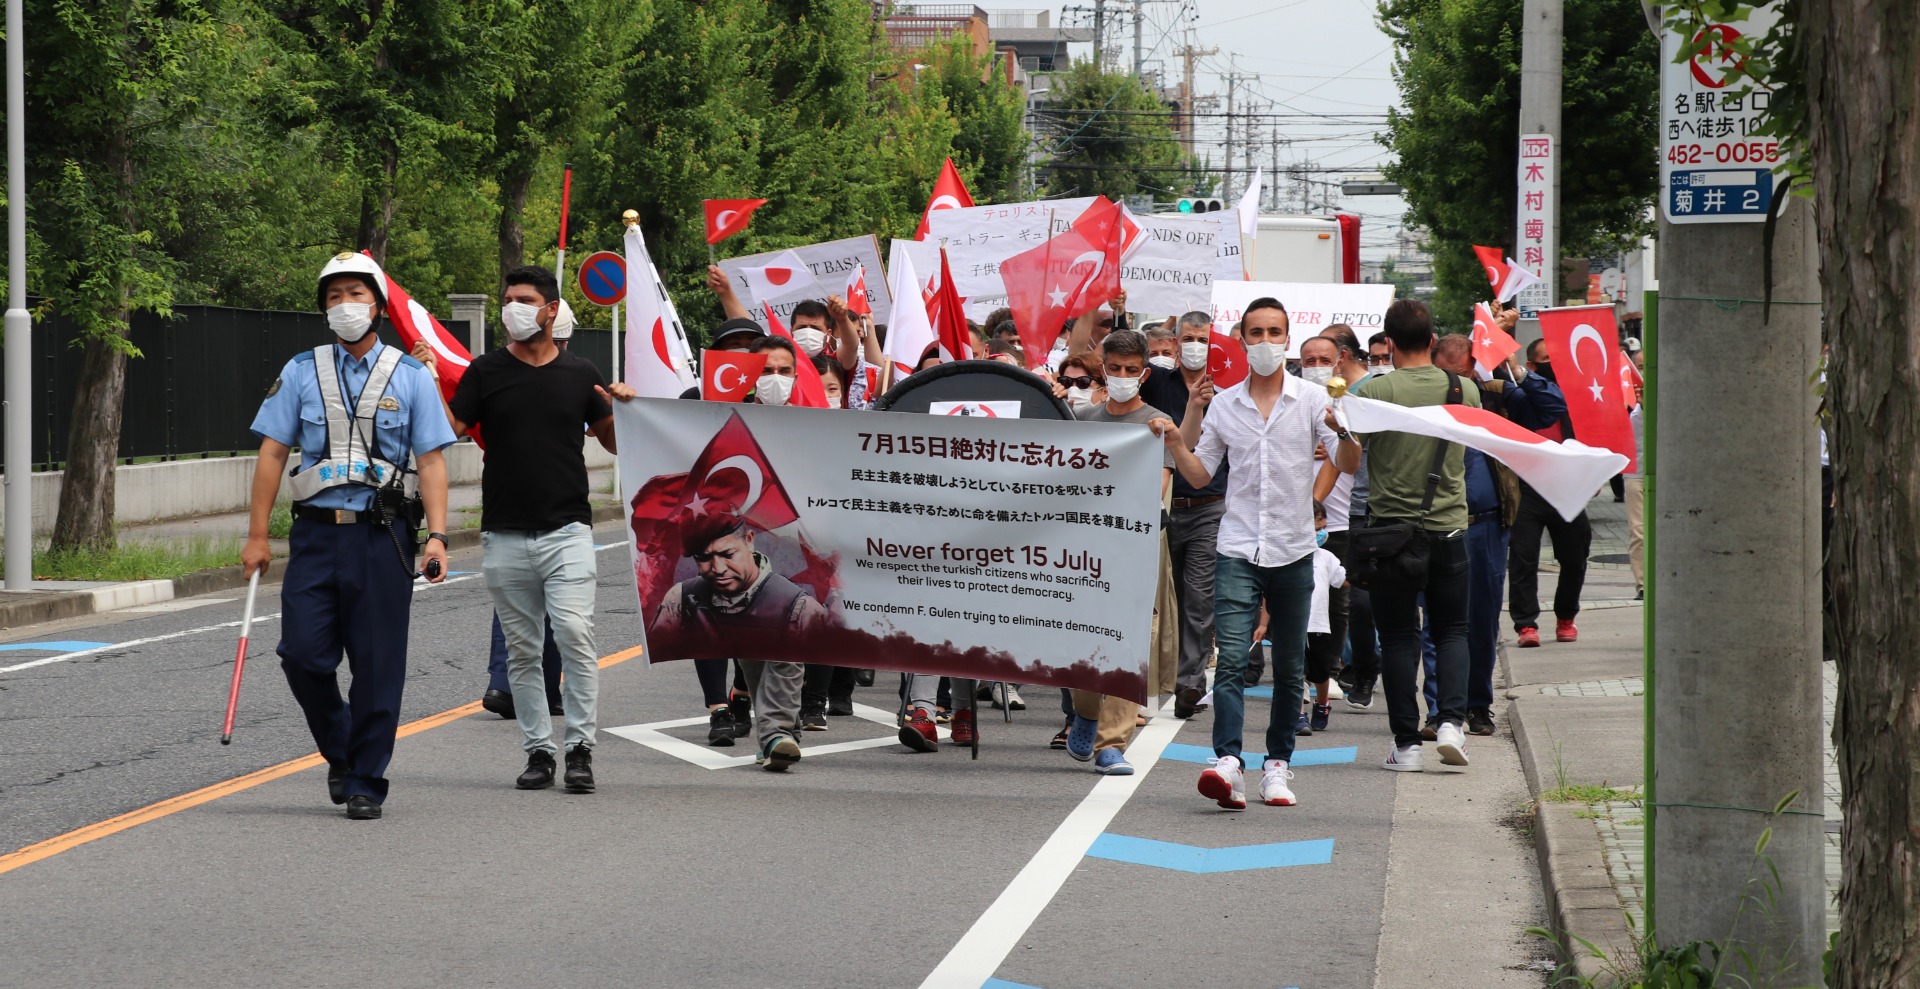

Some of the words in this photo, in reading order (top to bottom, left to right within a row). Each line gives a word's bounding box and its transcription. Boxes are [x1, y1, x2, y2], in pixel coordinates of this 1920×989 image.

[1675, 91, 1770, 114] 名駅西口
[1669, 117, 1766, 140] 西へ徒歩10
[1668, 143, 1779, 165] 452-0055
[1671, 176, 1689, 185] ここは
[1691, 174, 1705, 184] 許可
[984, 204, 1050, 221] テロリスト
[1525, 162, 1545, 267] 木村歯科
[1186, 231, 1215, 246] OFF
[1119, 266, 1212, 285] DEMOCRACY
[1287, 311, 1322, 325] VER
[1331, 312, 1382, 326] FETO
[858, 432, 1110, 470] 7月15日絶対に忘れるな
[851, 468, 1115, 497] 民主主義を破壊しようとしているFETOを呪います
[807, 496, 1152, 535] トルコで民主主義を守るために命を備えたトルコ国民を尊重します
[866, 537, 935, 559] Never
[941, 542, 1014, 567] forget
[1021, 545, 1048, 567] 15
[1053, 549, 1102, 579] July
[855, 559, 874, 569] We
[876, 562, 919, 573] respect
[921, 563, 940, 573] the
[943, 564, 982, 576] turkish
[985, 567, 1028, 580] citizens
[1030, 572, 1053, 583] who
[1055, 576, 1110, 593] sacrificing
[897, 575, 924, 586] their
[926, 577, 951, 588] lives
[954, 580, 965, 590] to
[968, 582, 1009, 594] protect
[1011, 584, 1075, 602] democracy.
[843, 600, 861, 611] We
[863, 602, 915, 615] condemn
[917, 605, 927, 616] F.
[929, 607, 961, 619] Gulen
[963, 610, 996, 625] trying
[998, 613, 1010, 624] to
[1012, 615, 1063, 629] eliminate
[1065, 619, 1124, 641] democracy.
